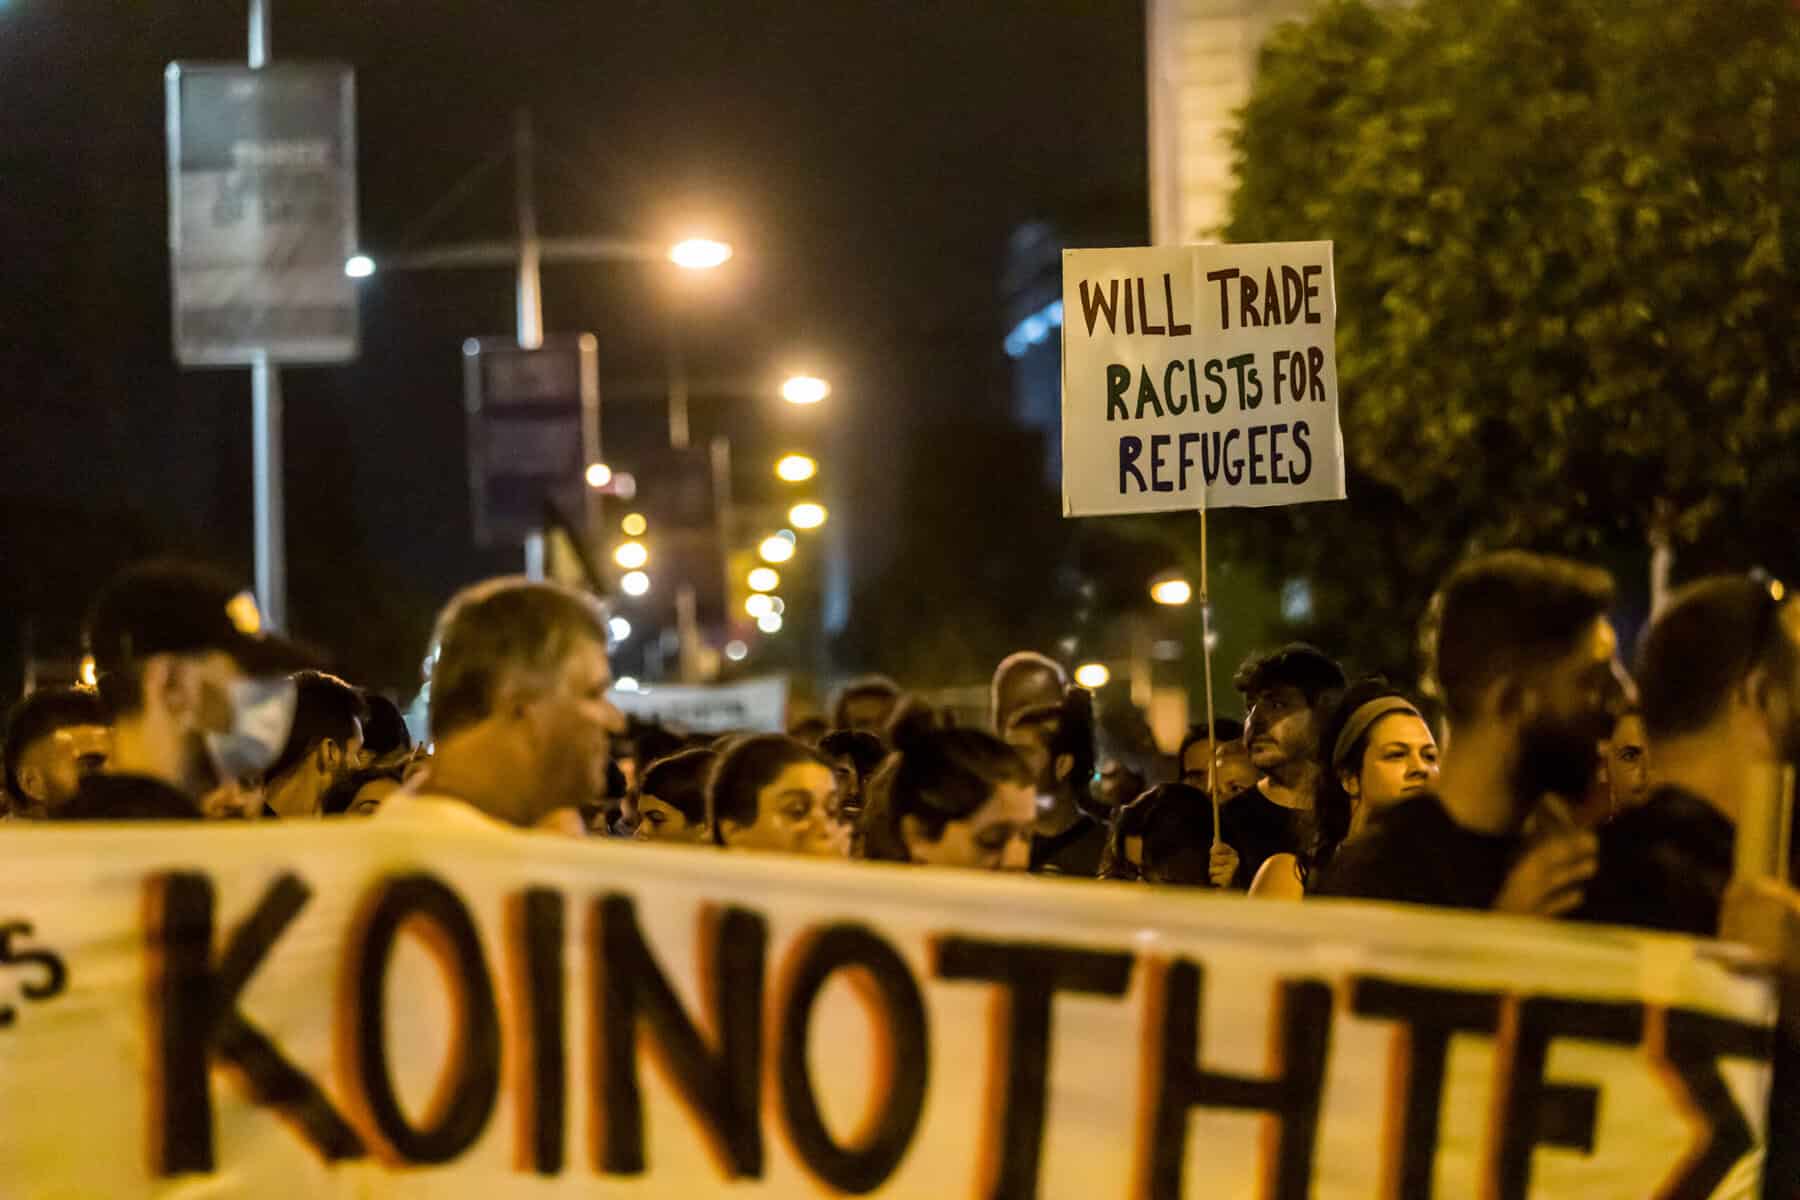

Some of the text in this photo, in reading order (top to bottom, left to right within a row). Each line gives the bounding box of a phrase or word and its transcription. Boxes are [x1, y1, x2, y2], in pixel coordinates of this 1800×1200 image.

[1078, 273, 1192, 338] WILL
[1273, 346, 1326, 405] FOR
[1119, 420, 1313, 494] REFUGEES
